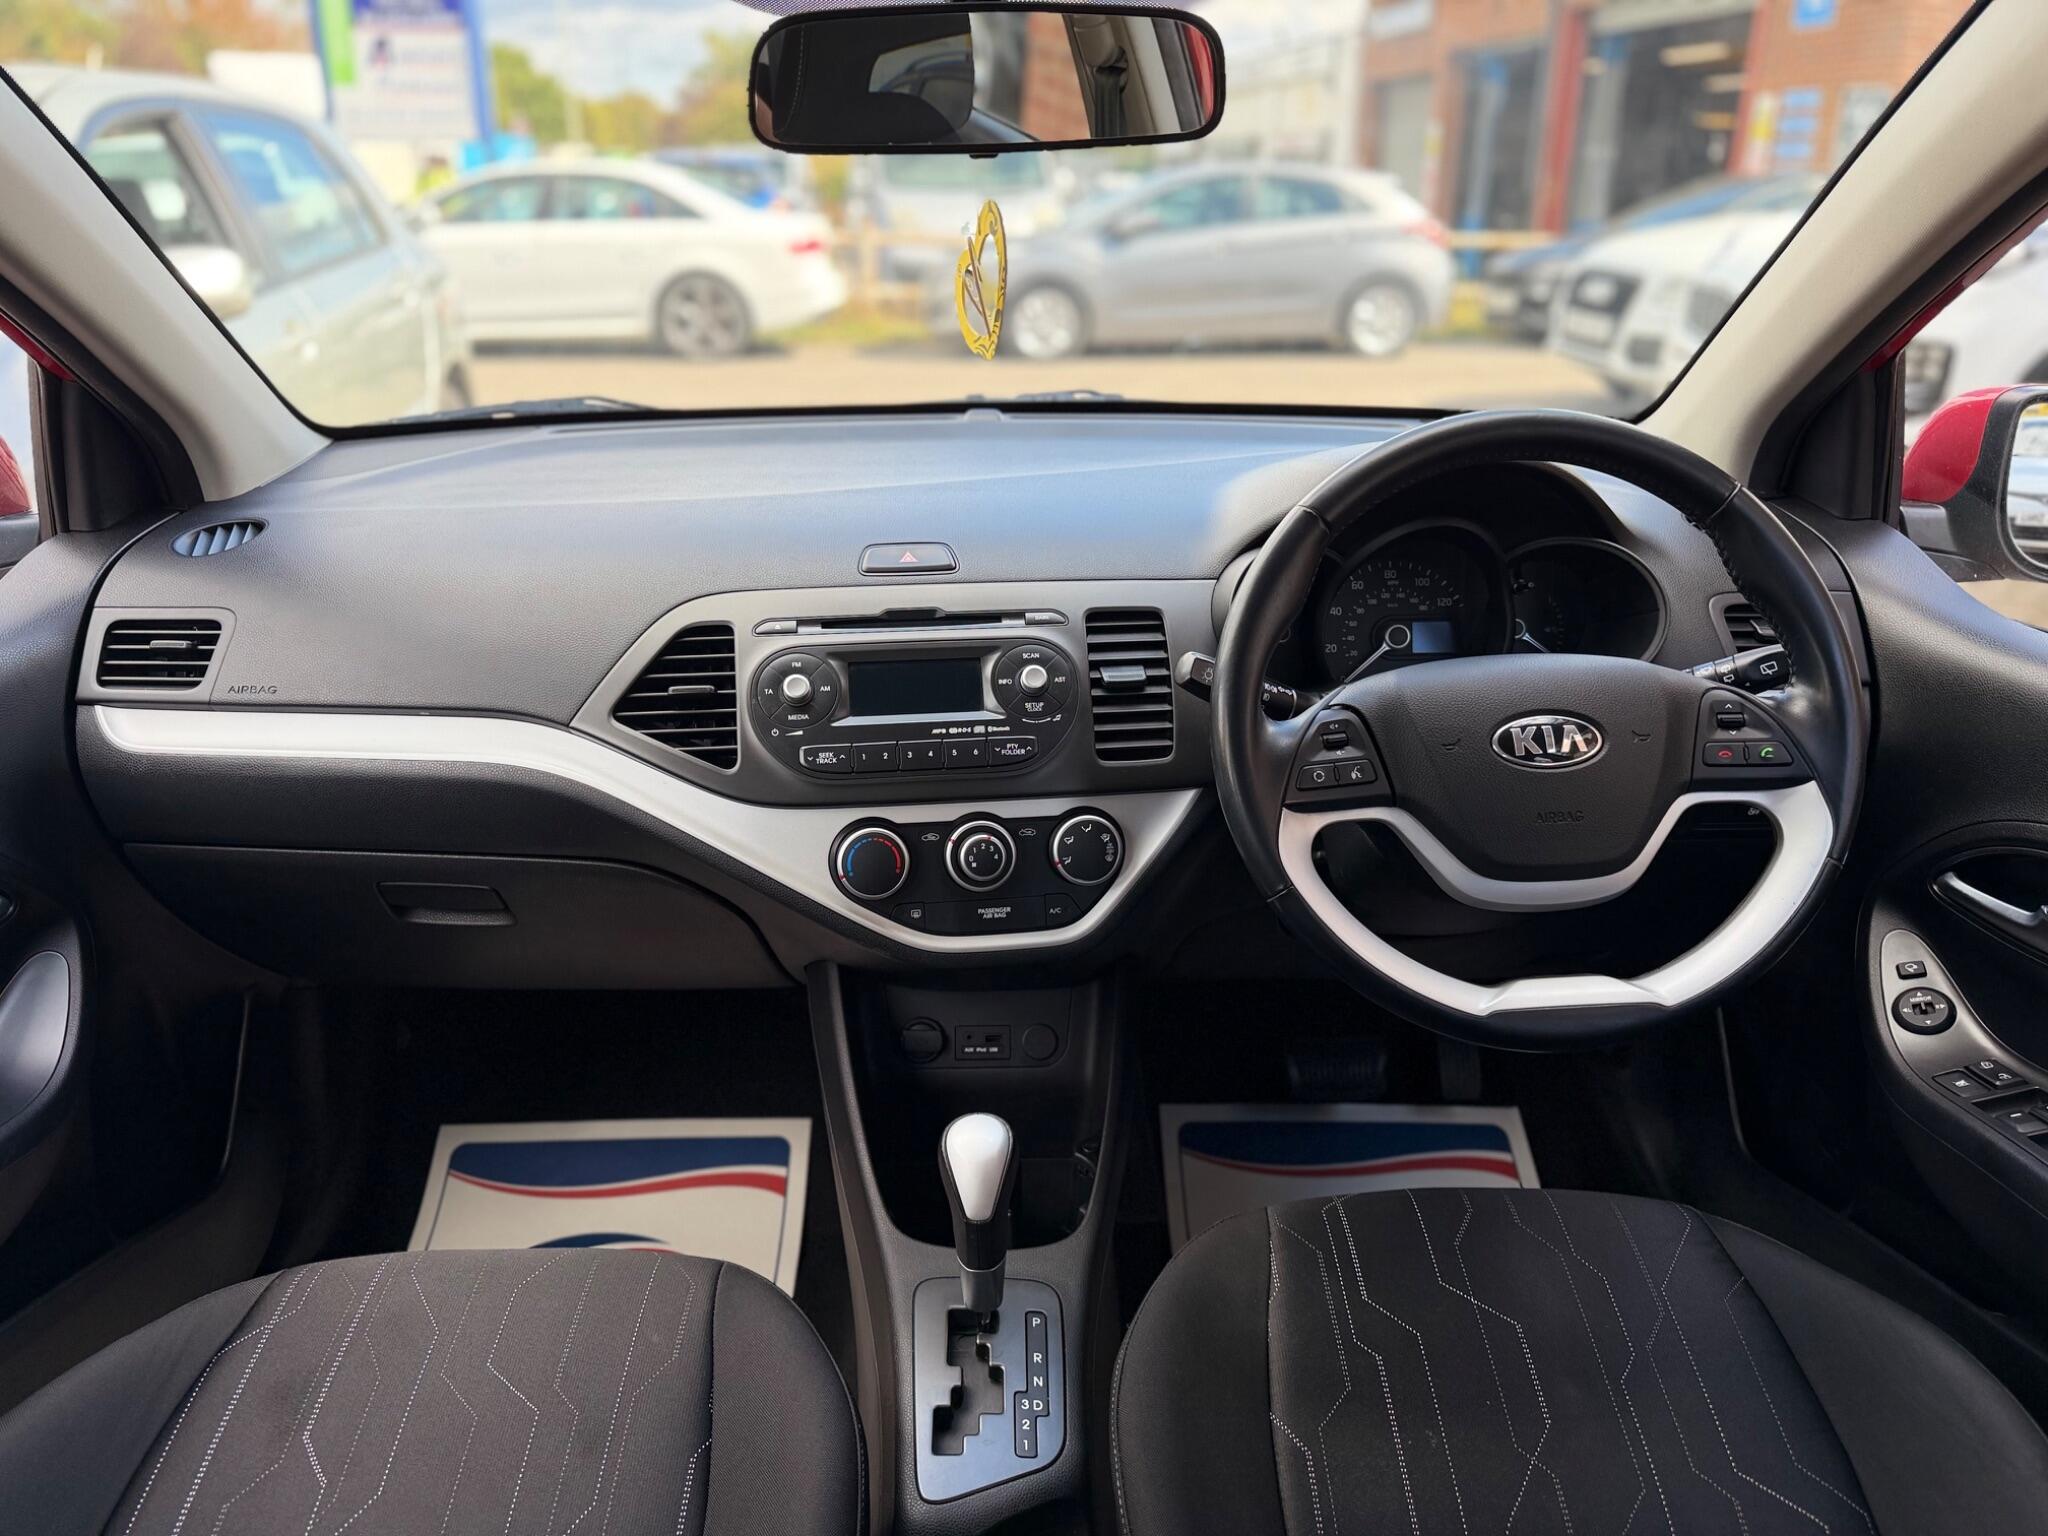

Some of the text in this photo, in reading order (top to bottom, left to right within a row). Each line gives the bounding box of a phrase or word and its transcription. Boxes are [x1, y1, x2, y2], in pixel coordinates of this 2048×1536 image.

[1384, 569, 1397, 579] 80
[1351, 581, 1364, 590] 60
[1415, 577, 1430, 586] 100
[1437, 598, 1452, 607] 120
[1329, 606, 1342, 616] 40
[1325, 643, 1337, 653] 20
[227, 685, 278, 695] AIRBAG
[1509, 724, 1589, 757] KIA
[882, 752, 889, 760] 2
[907, 751, 913, 759] 3
[928, 750, 934, 758] 4
[952, 748, 958, 757] 5
[973, 748, 979, 756] 6
[1001, 748, 1026, 756] FOLDER
[815, 757, 837, 765] TRACK
[1536, 810, 1584, 824] AIRBAG
[980, 842, 986, 850] 2
[1032, 1317, 1041, 1327] P
[1033, 1352, 1043, 1364] R
[1033, 1376, 1043, 1388] N
[1021, 1399, 1043, 1411] 3 D
[1022, 1419, 1030, 1430] 2
[1023, 1440, 1028, 1451] 1
